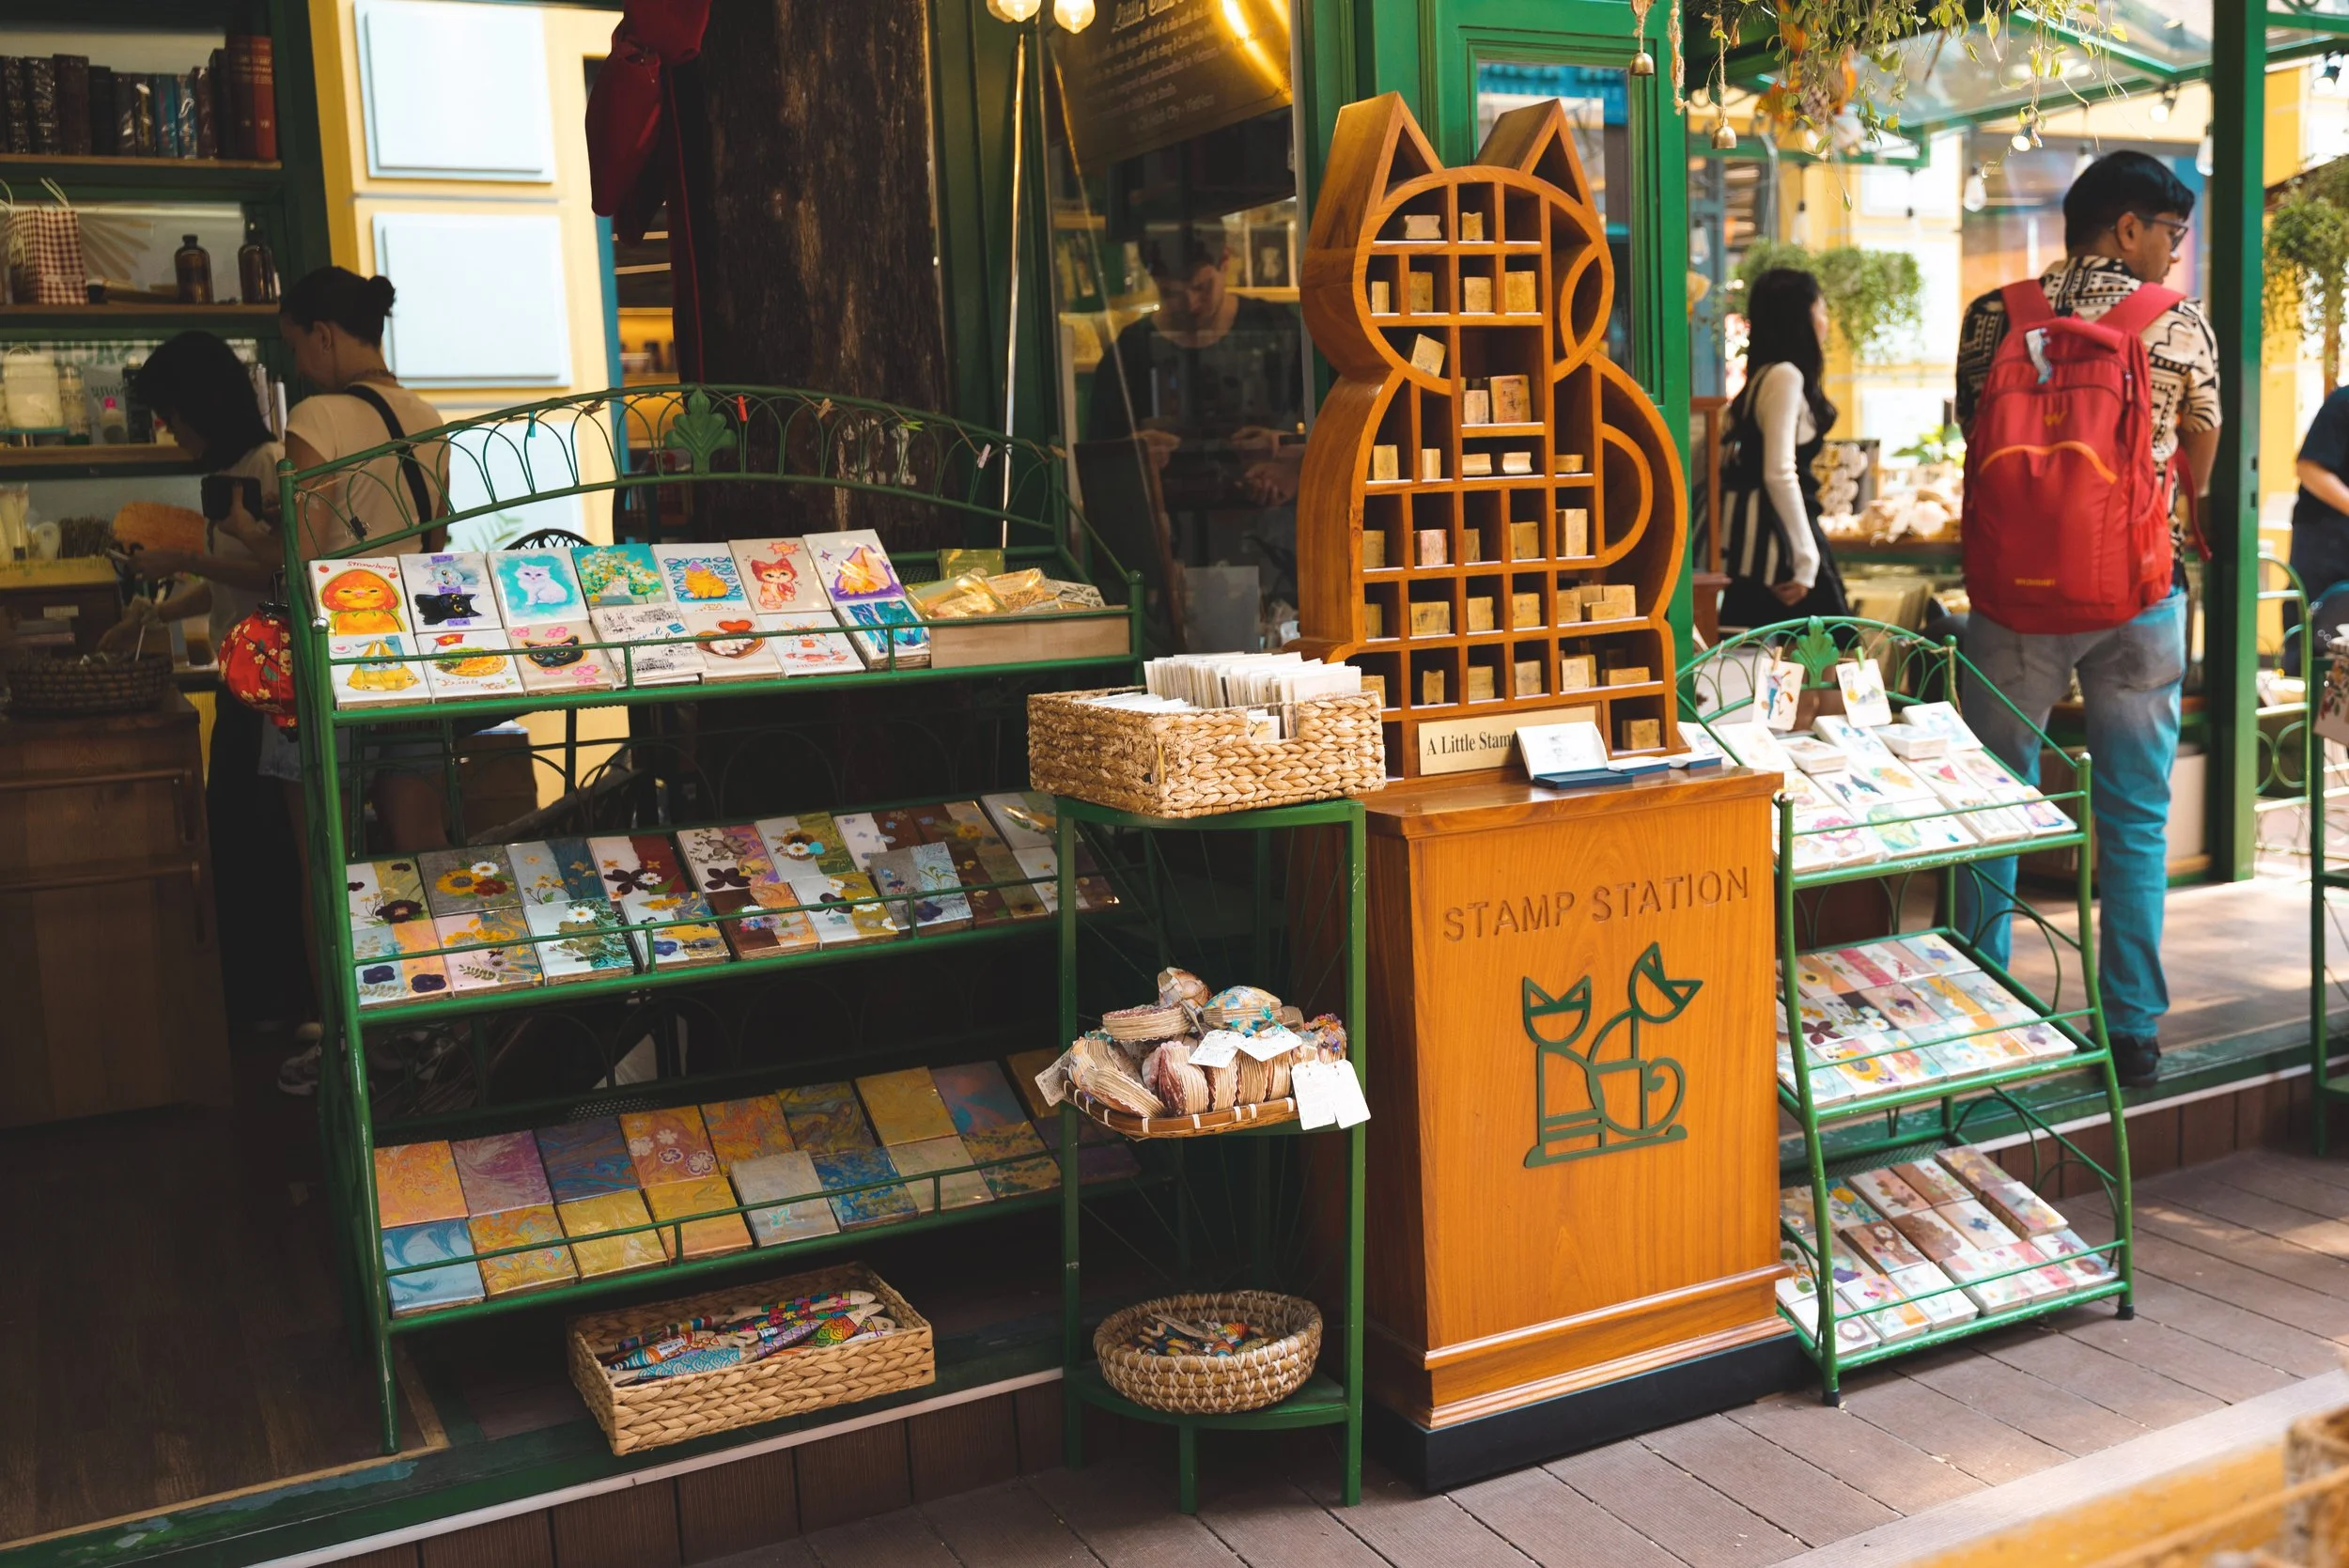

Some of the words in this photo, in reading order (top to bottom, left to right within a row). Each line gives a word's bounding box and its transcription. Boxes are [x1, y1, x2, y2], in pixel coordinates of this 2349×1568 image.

[347, 561, 397, 572] Strawberry
[1426, 737, 1438, 755] A
[1441, 734, 1476, 753] Little
[1479, 731, 1514, 750] Stam
[1443, 892, 1575, 940] STAMP
[1592, 866, 1748, 923] STATION
